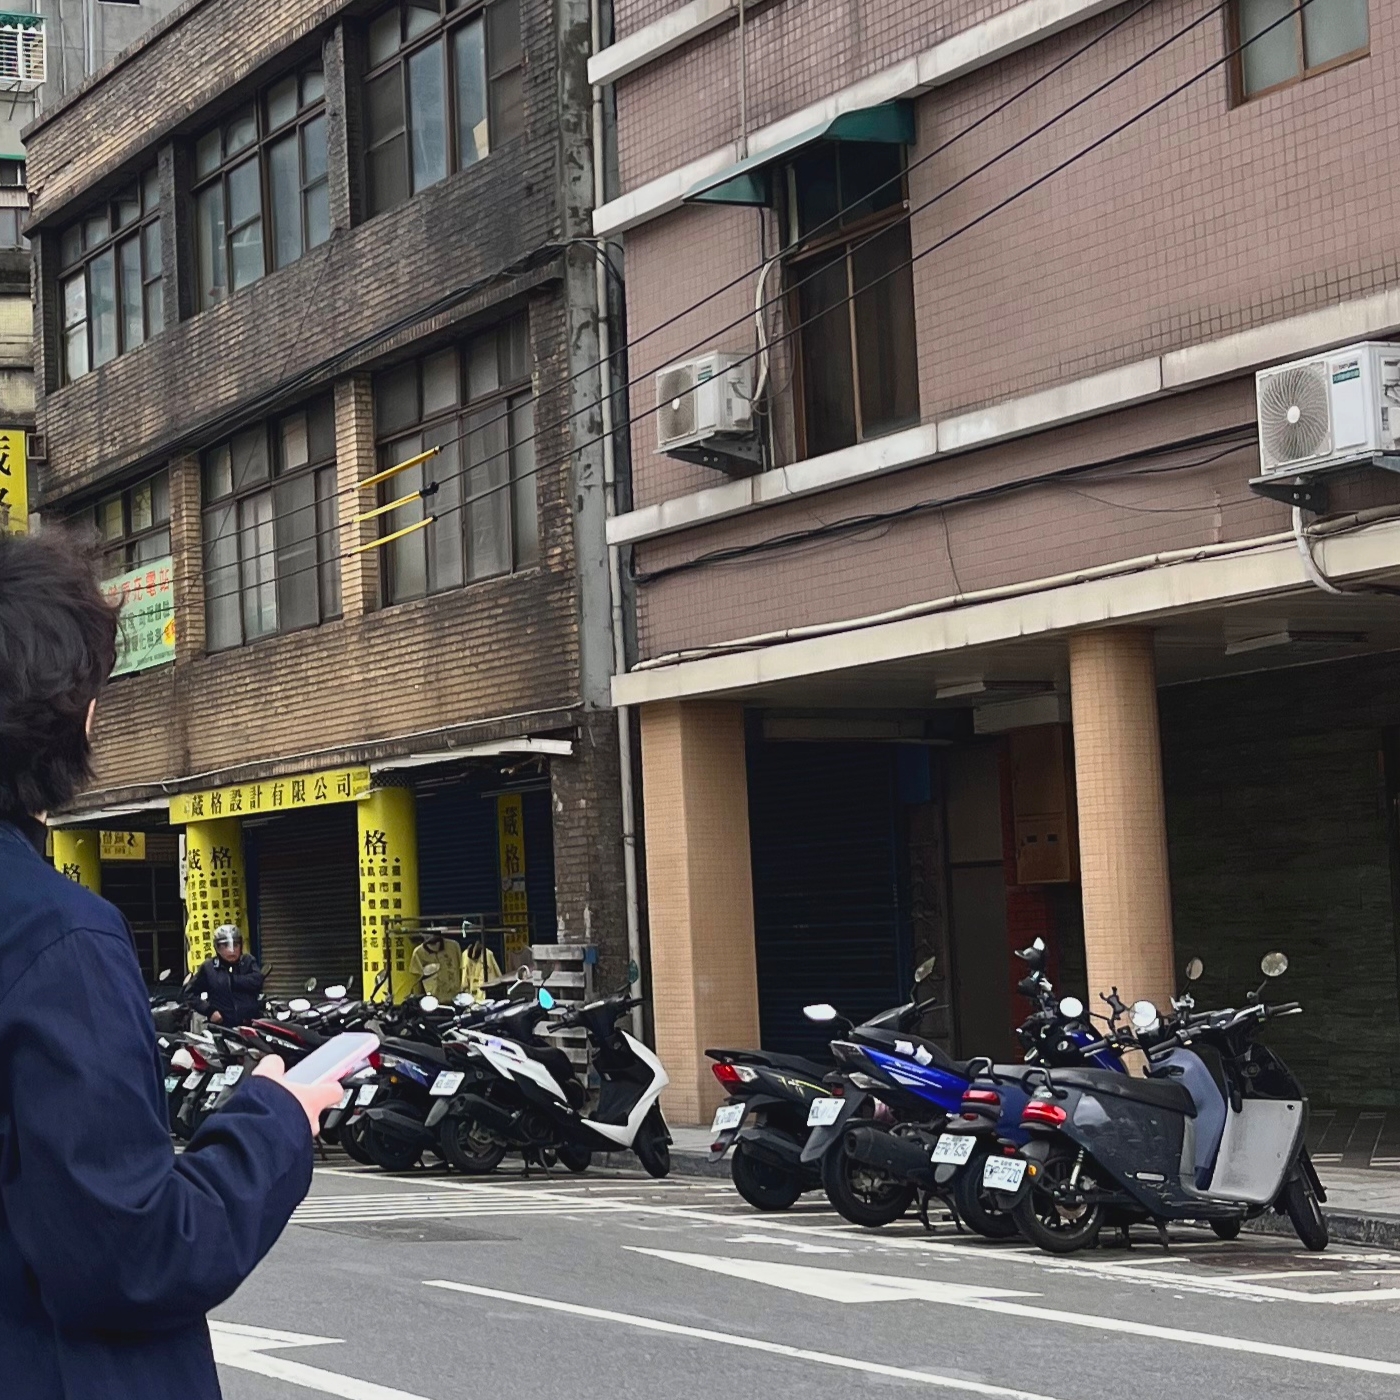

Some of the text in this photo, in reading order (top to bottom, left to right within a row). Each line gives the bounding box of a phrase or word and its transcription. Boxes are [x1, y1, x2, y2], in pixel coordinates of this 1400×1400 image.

[191, 773, 351, 818] 葳格設計有限公司
